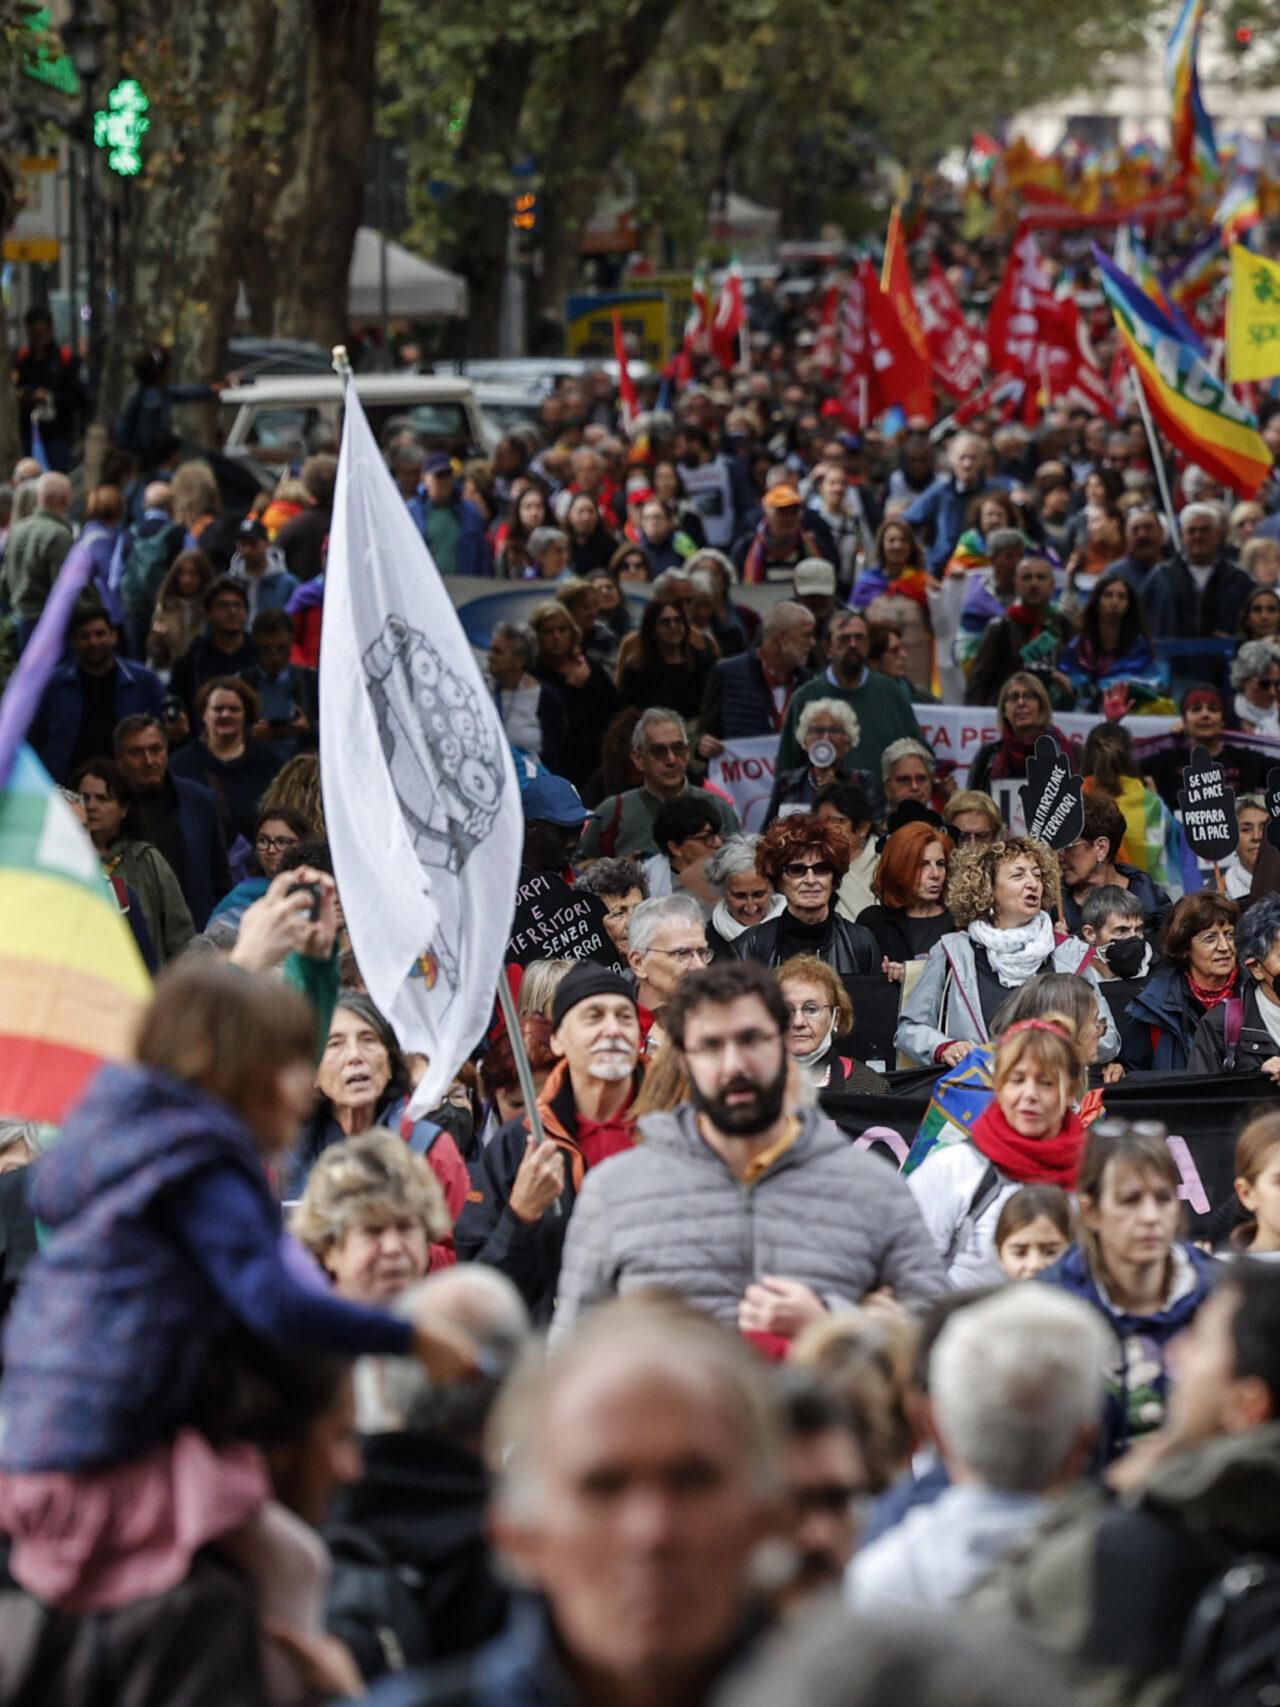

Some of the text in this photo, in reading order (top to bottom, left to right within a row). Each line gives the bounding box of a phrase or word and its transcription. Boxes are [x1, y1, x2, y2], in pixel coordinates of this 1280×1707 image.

[1189, 769, 1221, 788] SE VUOI
[1188, 783, 1224, 804] LA PACE
[1041, 793, 1078, 841] TERRITORI
[1185, 808, 1226, 826] PREPARA
[1192, 824, 1230, 842] LA PACE
[530, 904, 545, 920] E
[506, 899, 592, 955] TERRITORI
[542, 920, 589, 958] SENZA
